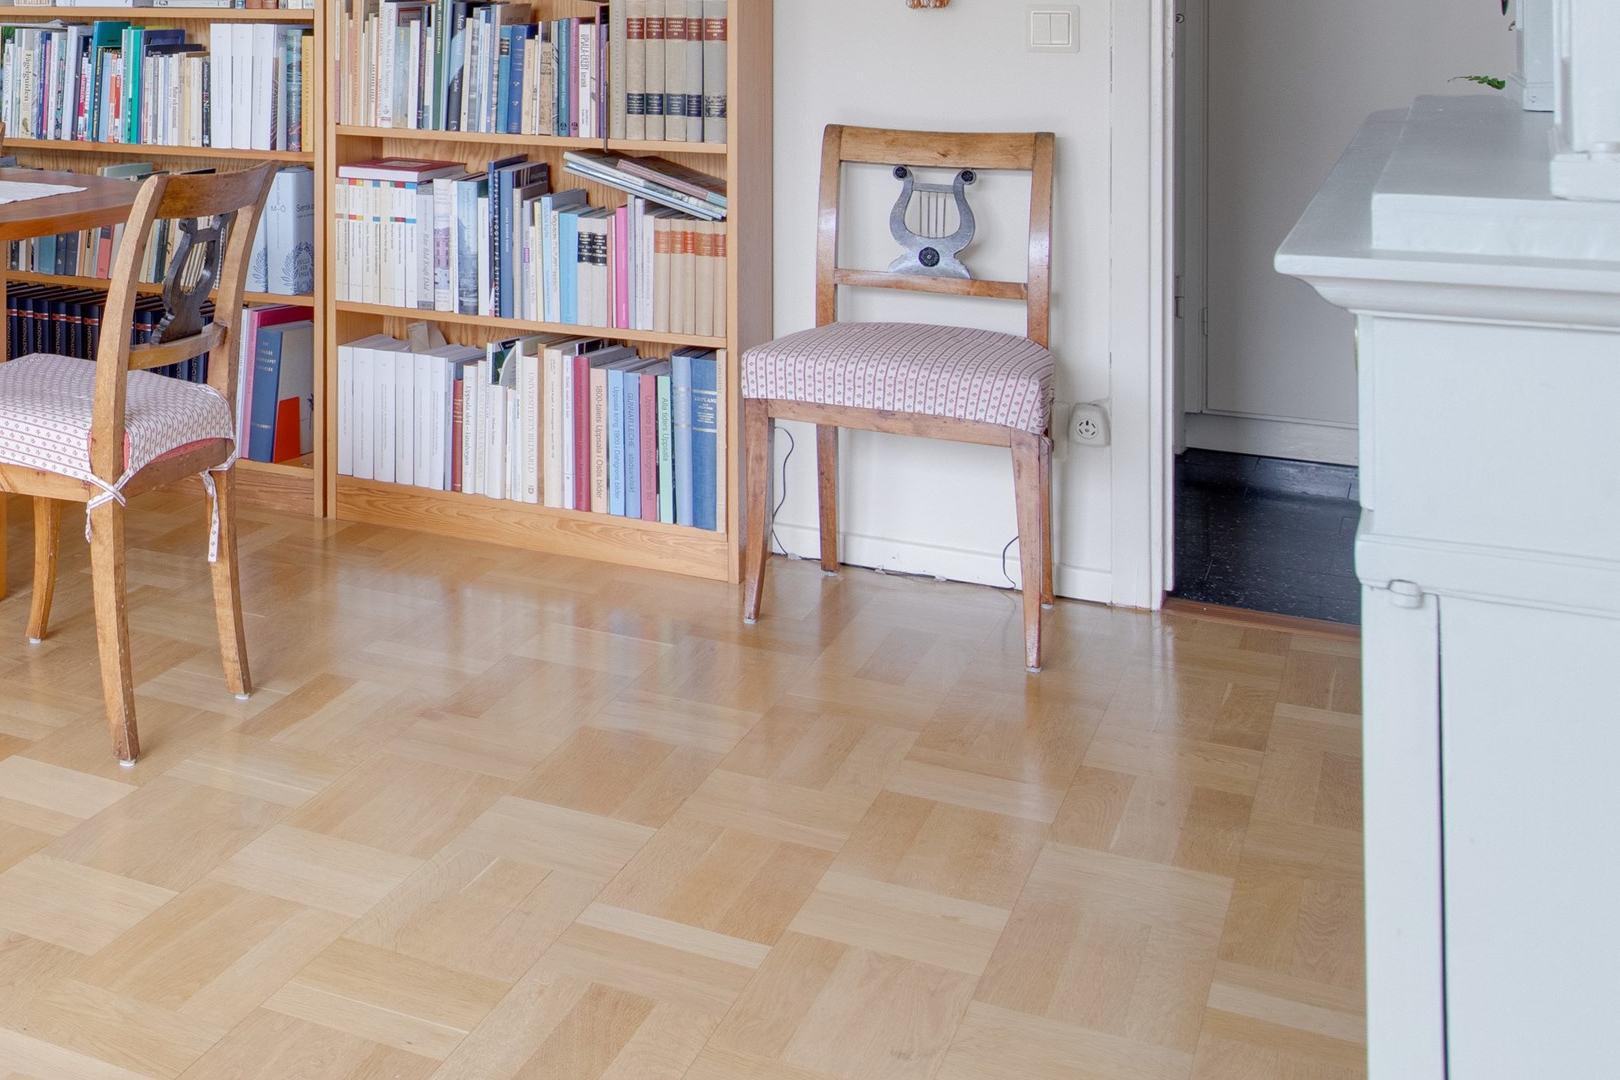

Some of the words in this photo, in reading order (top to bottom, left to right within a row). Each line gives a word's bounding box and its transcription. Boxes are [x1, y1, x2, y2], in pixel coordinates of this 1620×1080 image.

[23, 53, 32, 102] Fågelguiden
[464, 385, 472, 411] Uppsala
[595, 385, 603, 423] 1800-talets
[612, 386, 620, 412] Uppsala
[627, 392, 635, 423] GUNNAR
[661, 397, 669, 411] Alla
[612, 412, 620, 428] kring
[645, 426, 652, 436] på
[594, 424, 602, 453] Uppsala
[627, 424, 635, 448] LECHE
[661, 433, 670, 461] Uppsala
[613, 450, 621, 480] Dahlgrens
